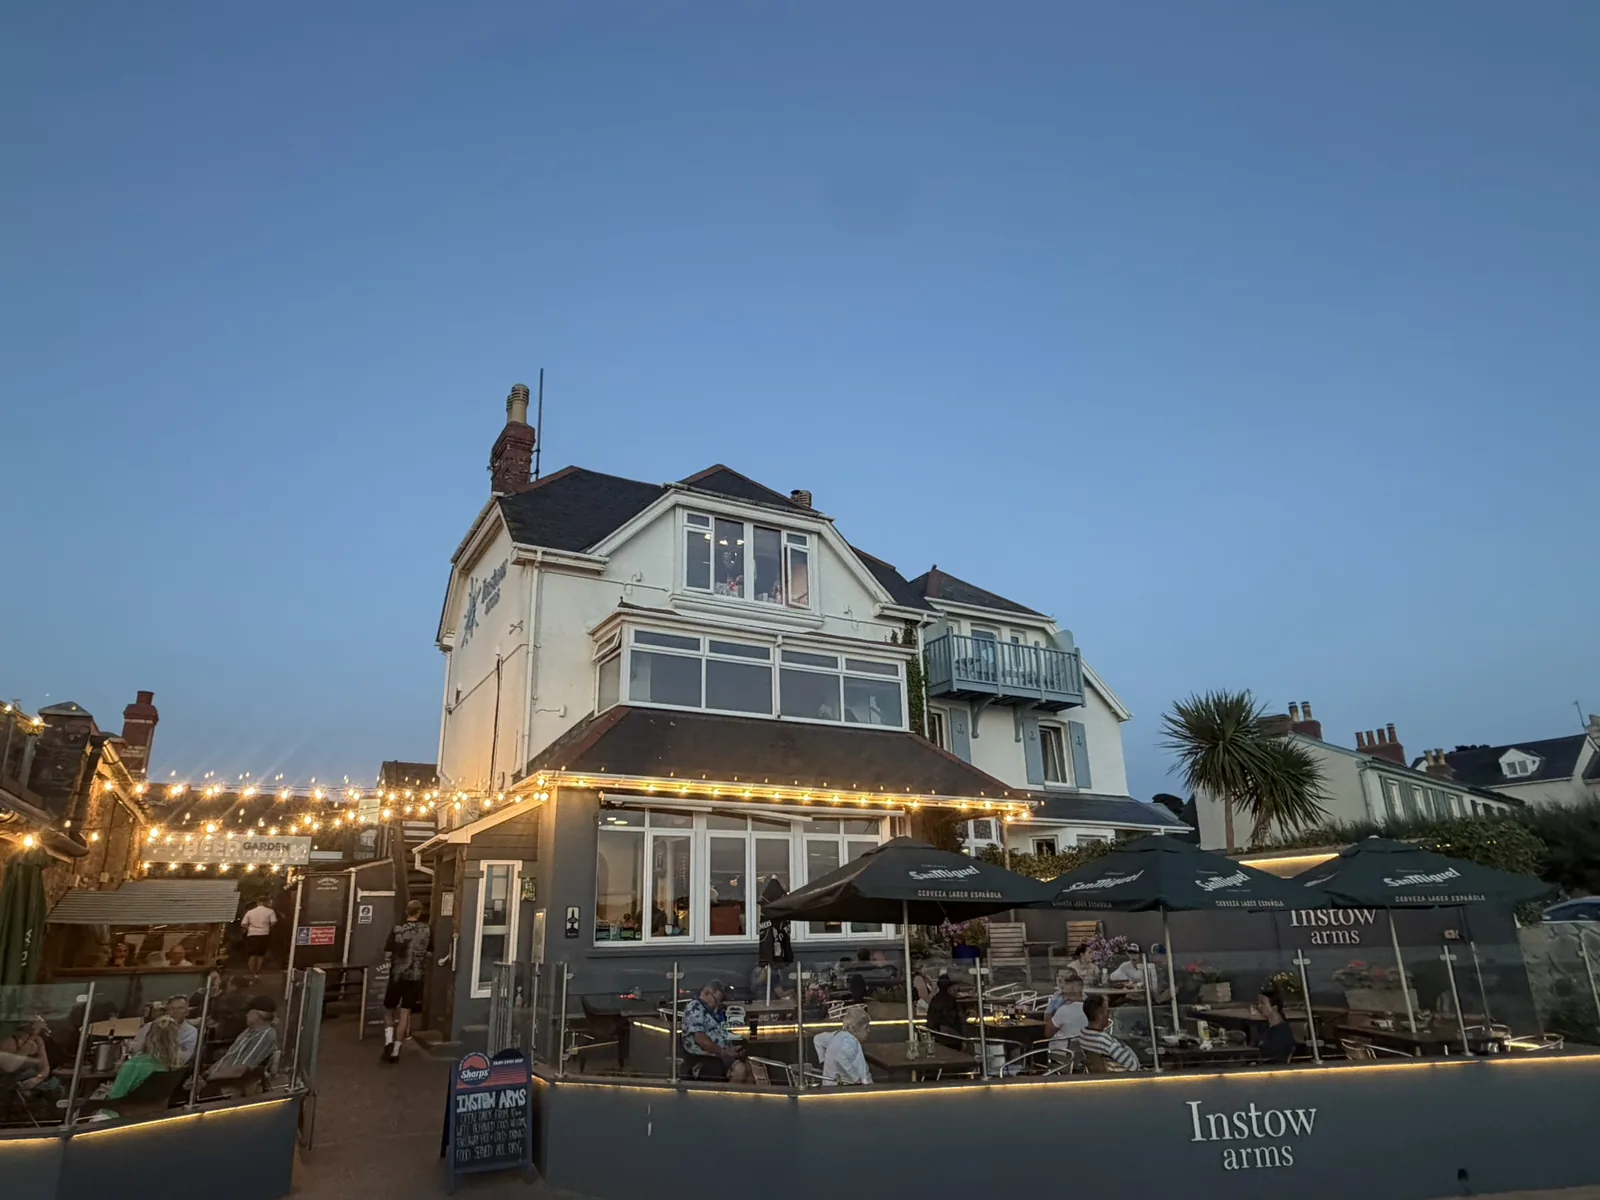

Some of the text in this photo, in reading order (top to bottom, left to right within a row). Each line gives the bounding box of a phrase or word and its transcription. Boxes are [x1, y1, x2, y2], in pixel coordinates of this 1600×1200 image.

[243, 842, 290, 851] GARDEN
[917, 889, 946, 898] CERVEZA
[1428, 894, 1449, 902] LAGER
[1290, 908, 1376, 927] Instow
[1311, 930, 1360, 945] arms
[498, 1088, 527, 1109] ARMS
[1186, 1100, 1317, 1142] Instow
[1223, 1145, 1294, 1171] arms
